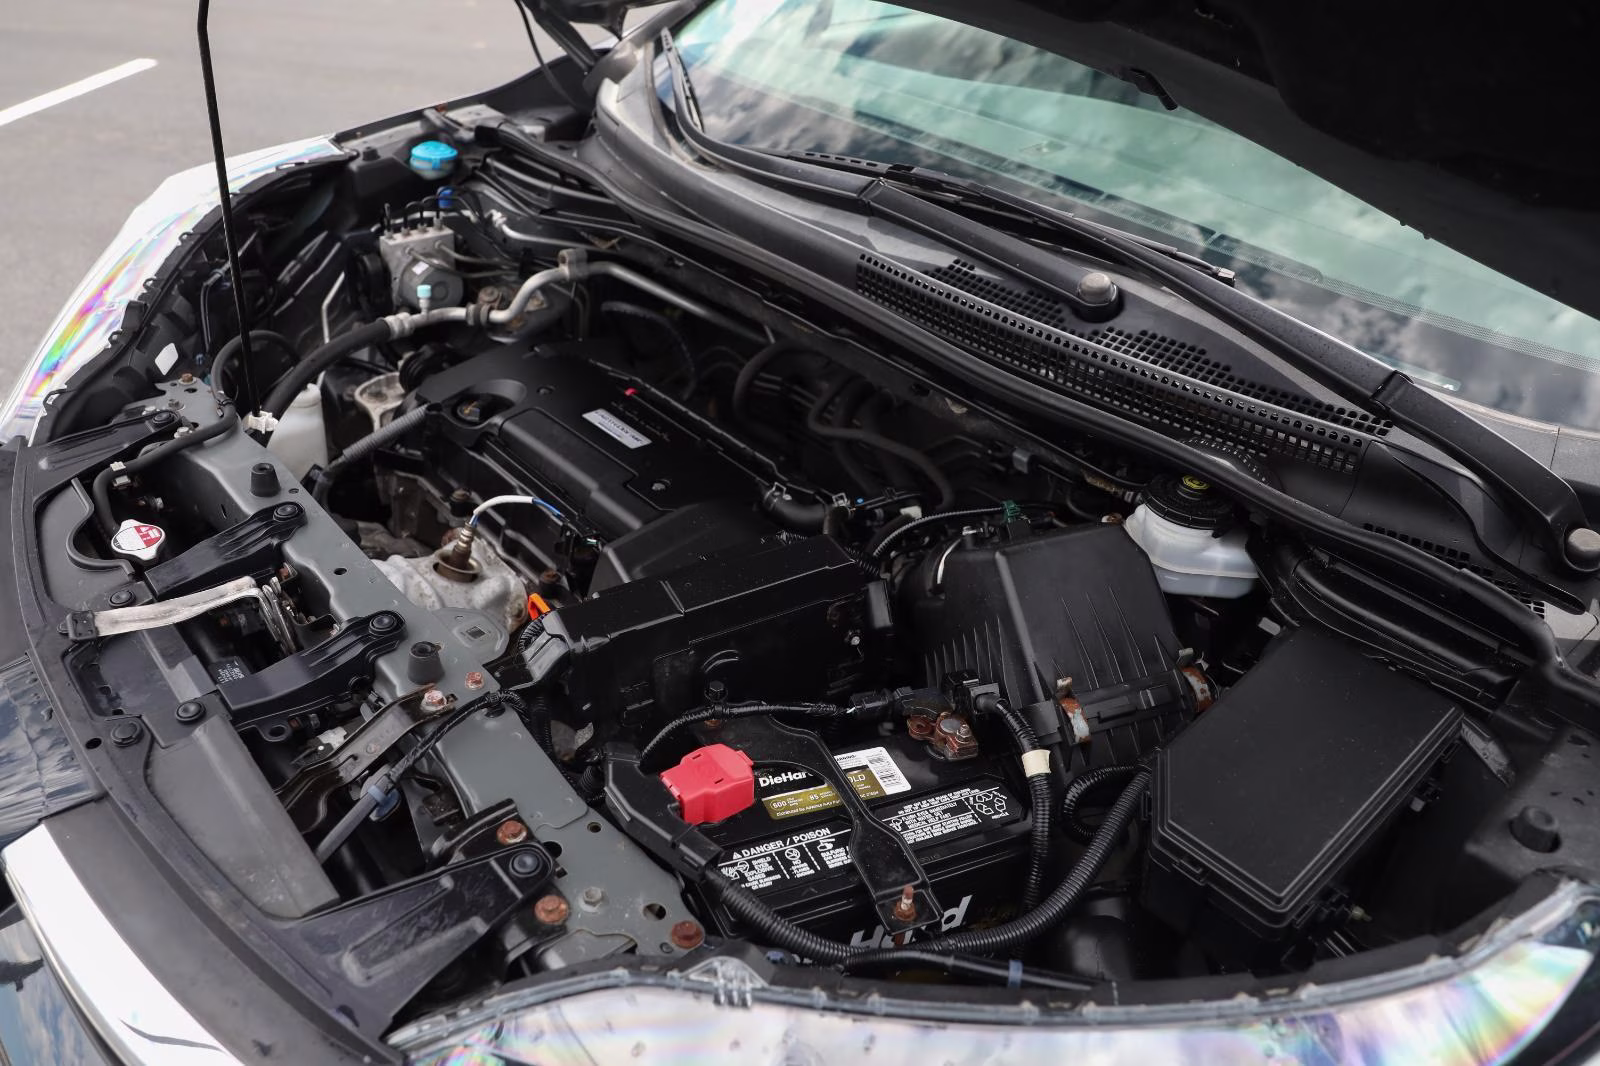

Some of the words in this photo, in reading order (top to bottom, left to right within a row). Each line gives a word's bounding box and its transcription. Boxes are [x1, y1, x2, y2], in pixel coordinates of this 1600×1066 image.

[758, 771, 814, 787] DieHar
[772, 800, 788, 808] 600
[741, 840, 785, 857] DANGER
[786, 837, 791, 846] /
[792, 827, 831, 844] POISON
